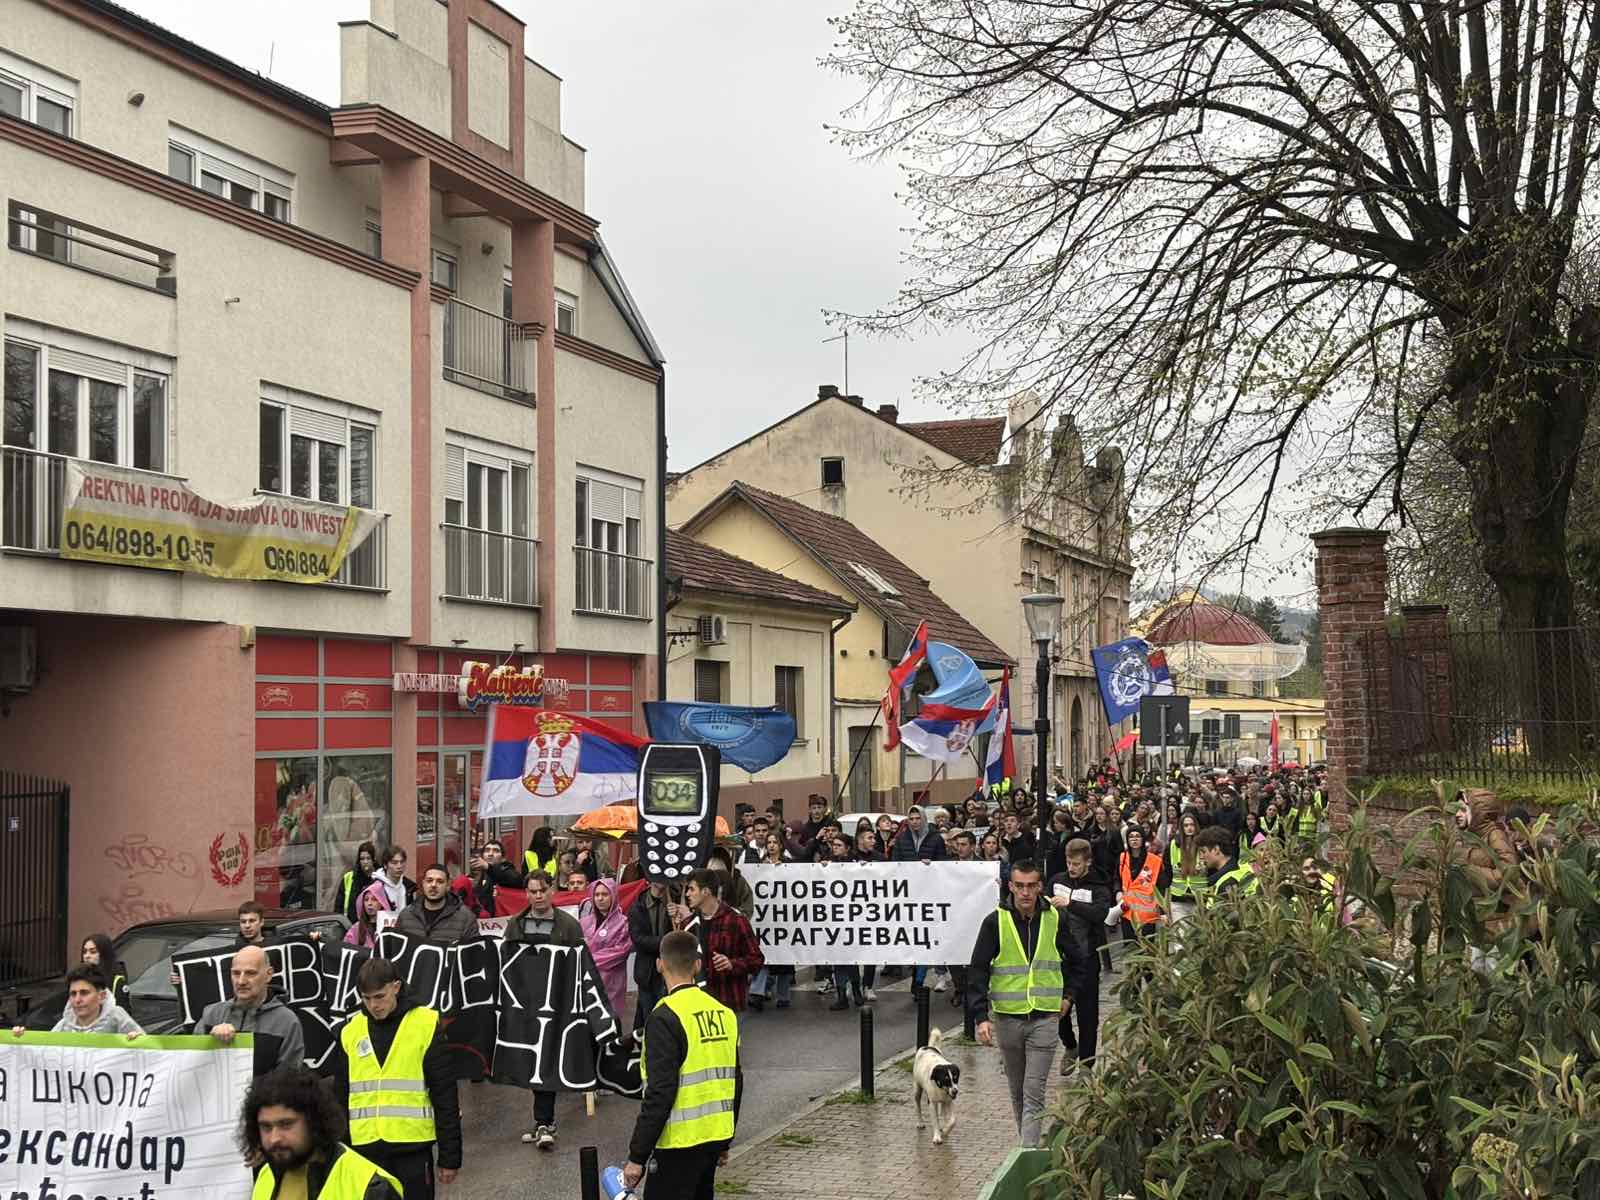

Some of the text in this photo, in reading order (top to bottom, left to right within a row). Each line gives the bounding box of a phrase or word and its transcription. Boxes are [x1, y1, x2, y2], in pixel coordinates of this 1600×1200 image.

[80, 475, 146, 507] REKTNA
[281, 507, 299, 529] OD
[754, 879, 909, 902] СЛОБОДНИ
[754, 903, 951, 922] УНИВЕРЗИТЕТ
[755, 927, 940, 949] КРАГУЈЕВАЦ.
